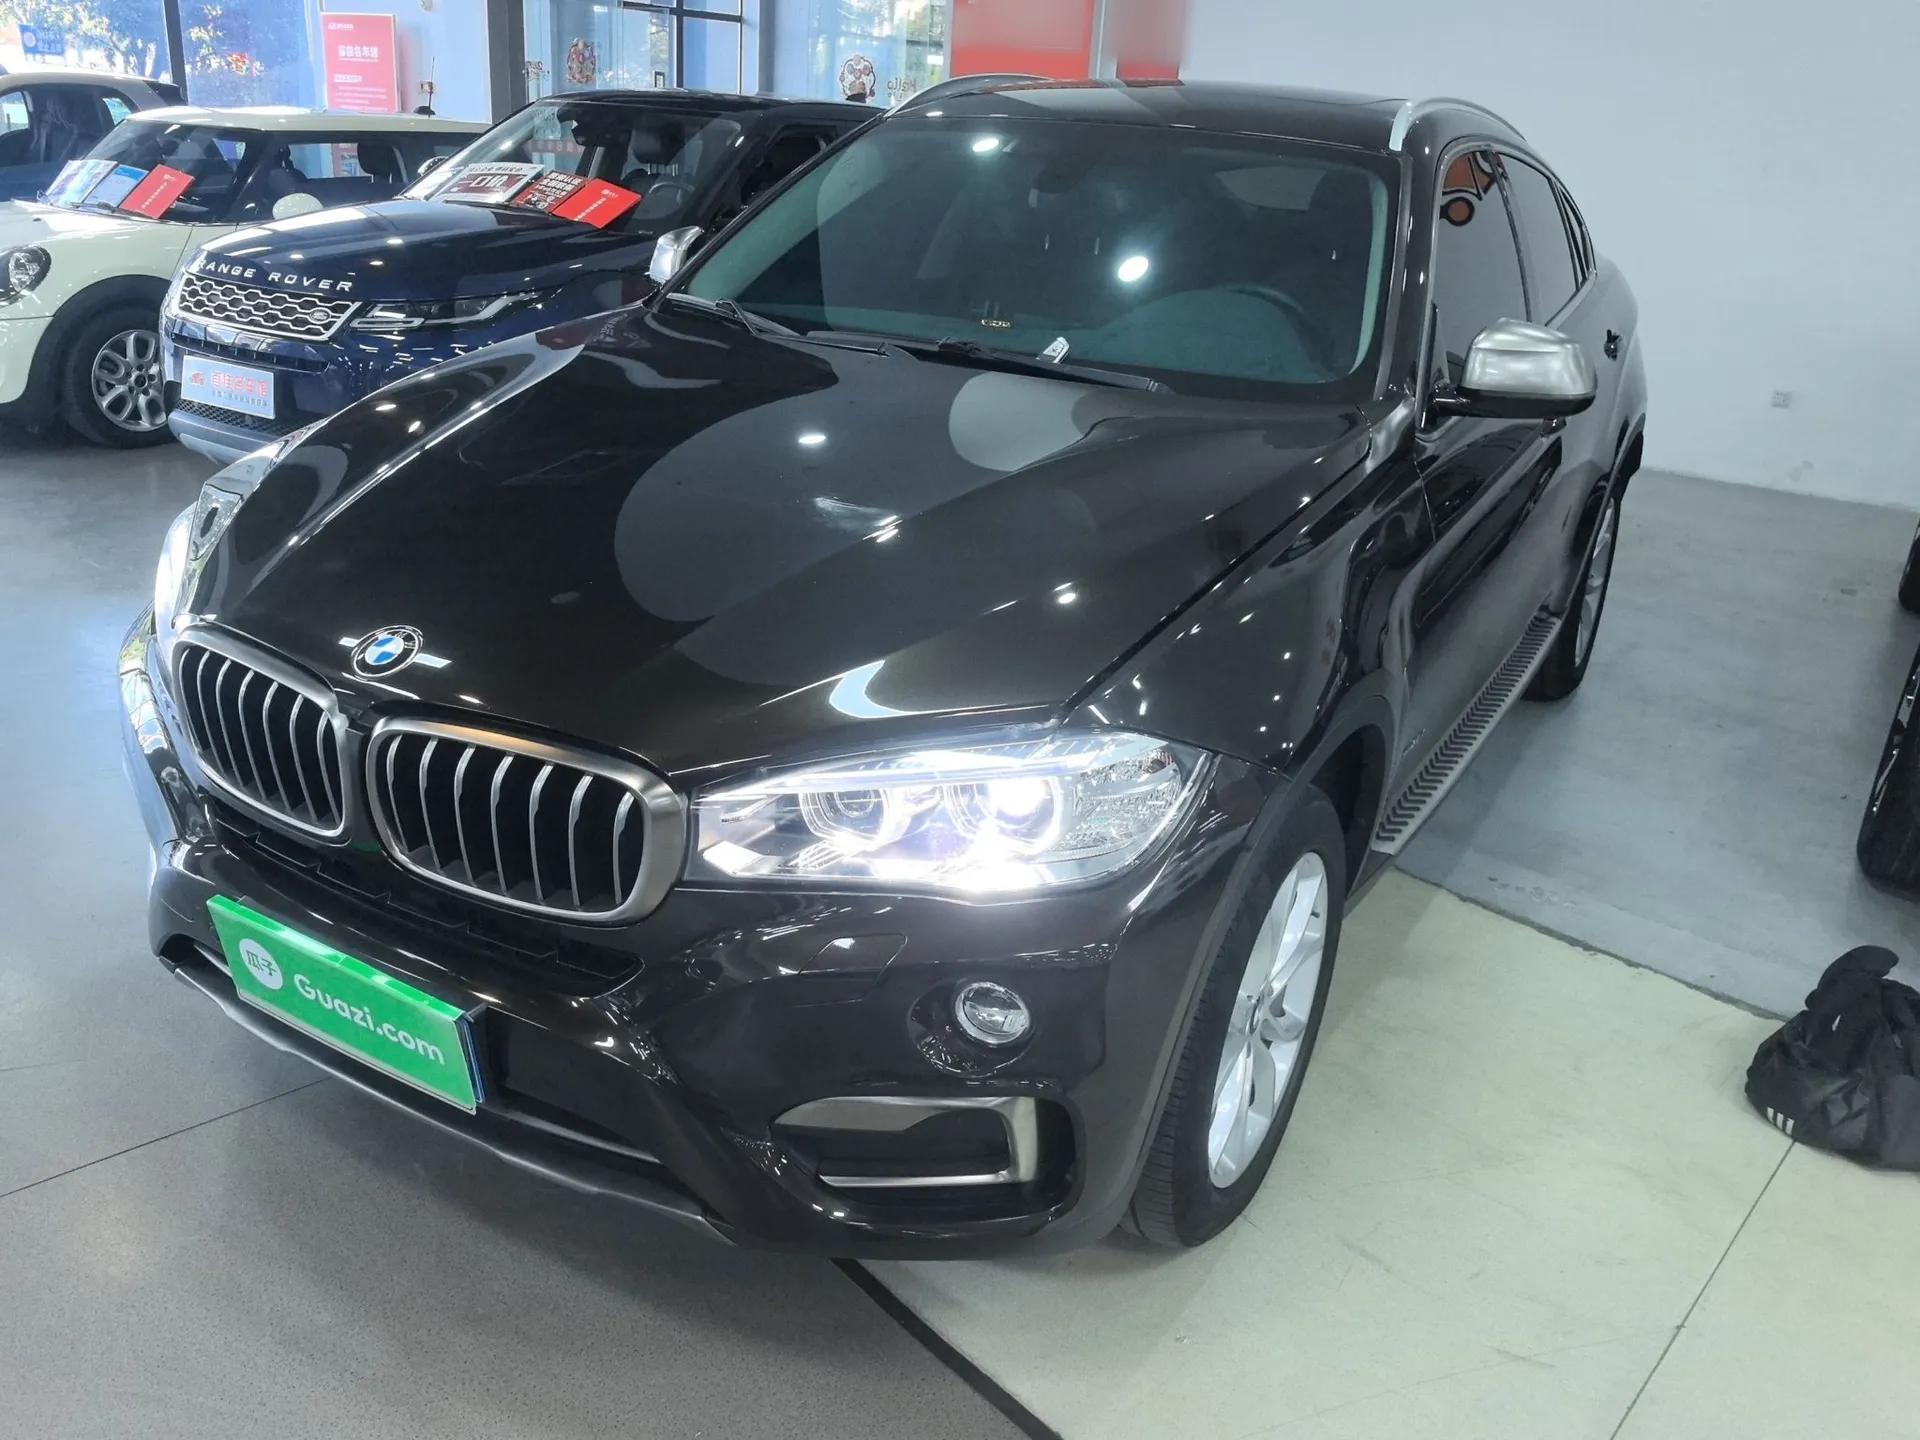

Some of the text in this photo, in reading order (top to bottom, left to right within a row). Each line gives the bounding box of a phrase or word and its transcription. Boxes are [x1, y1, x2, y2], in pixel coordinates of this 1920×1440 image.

[199, 257, 353, 292] RANGE ROVER
[245, 949, 278, 977] 瓜子
[293, 973, 445, 1065] Guazi.com
